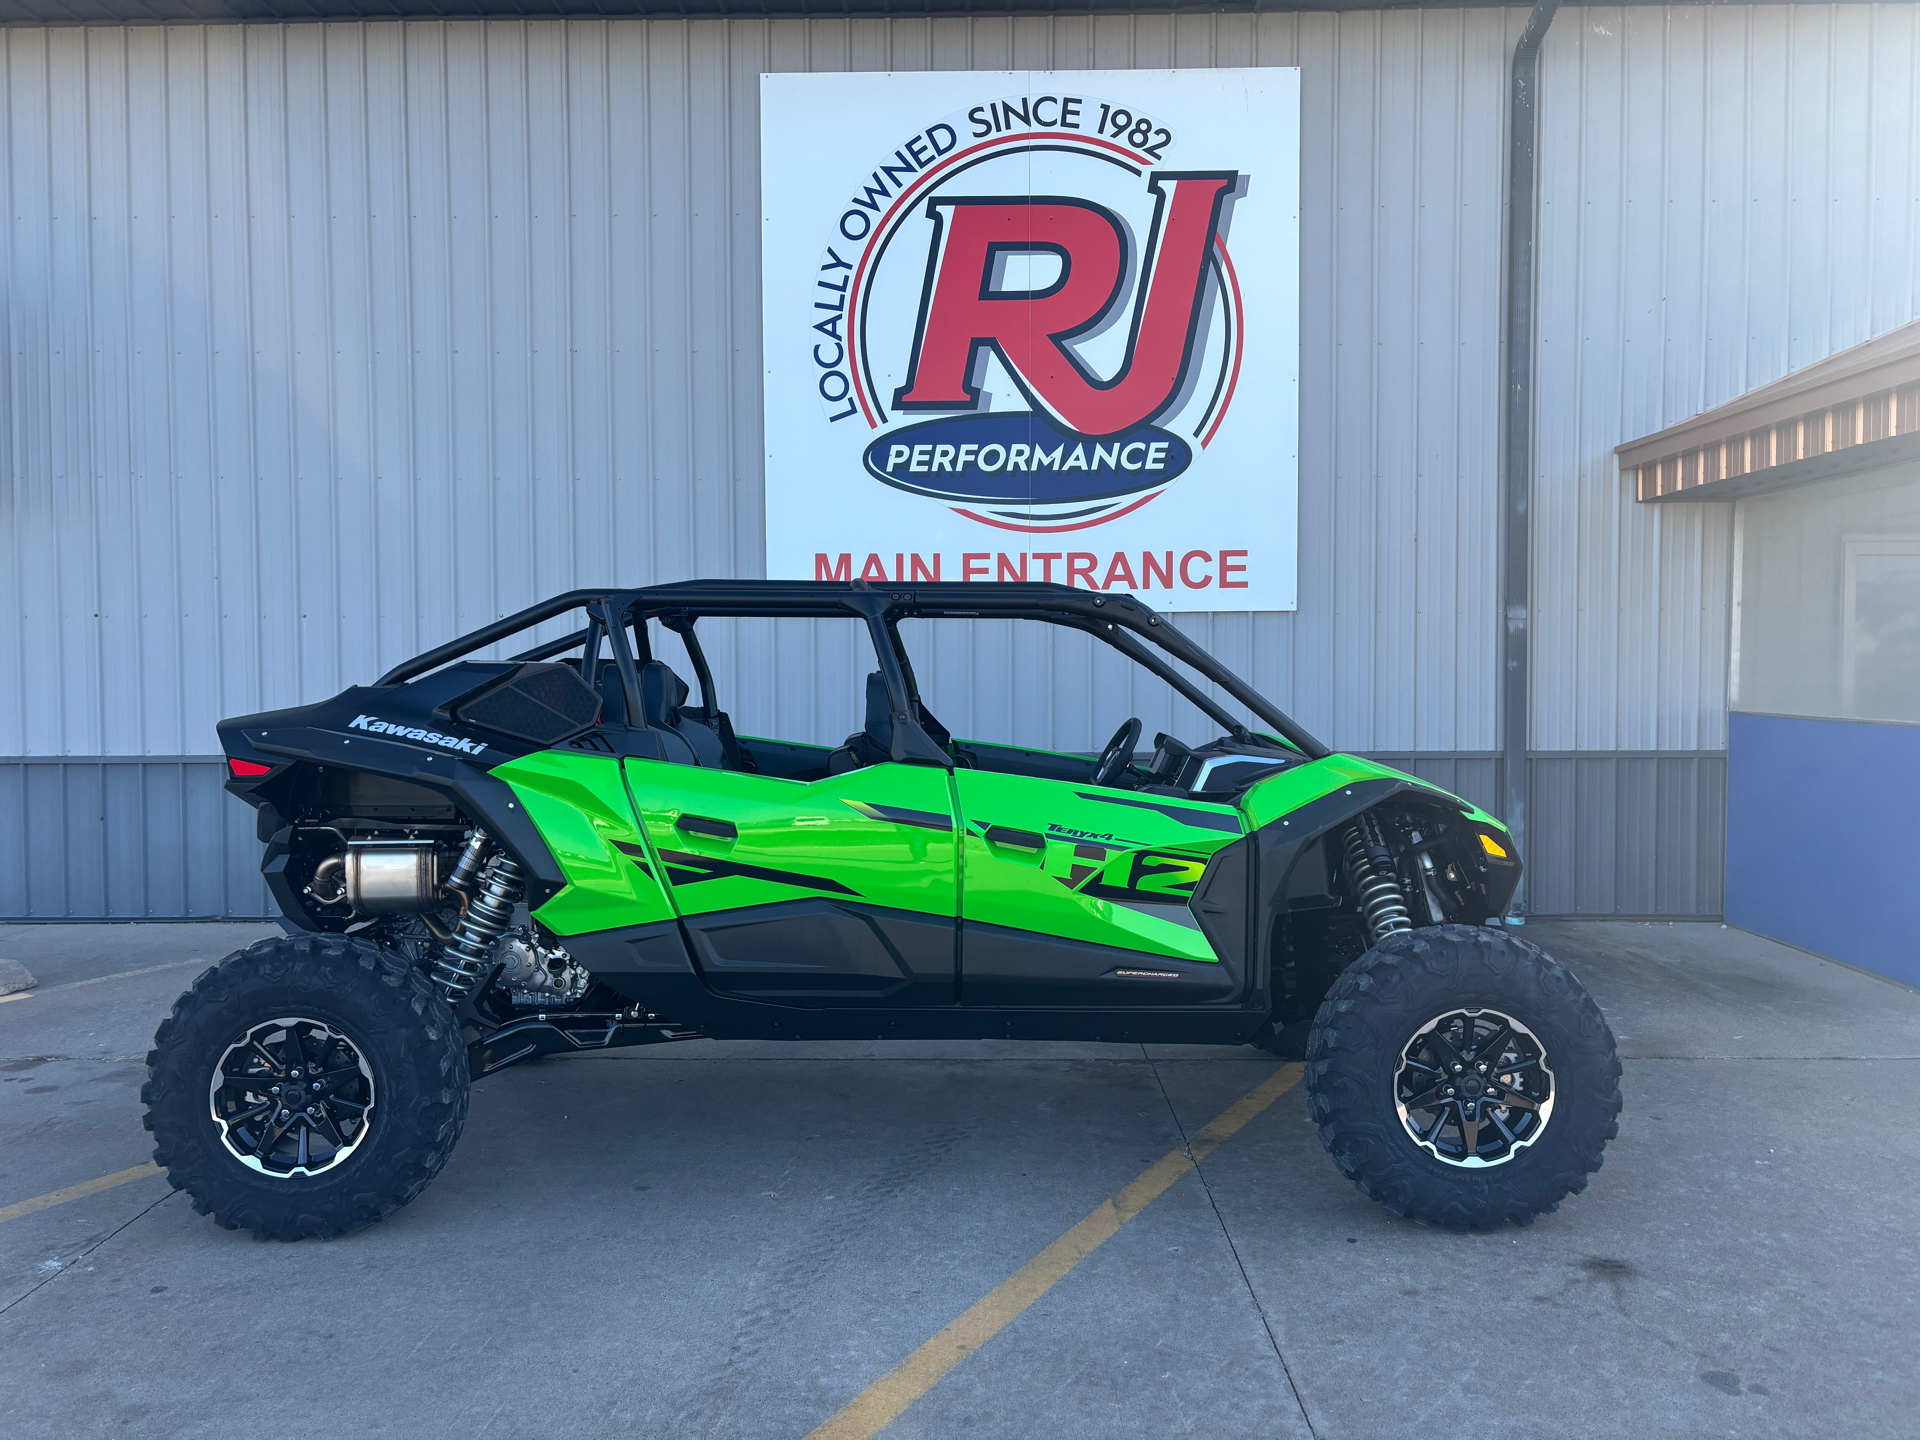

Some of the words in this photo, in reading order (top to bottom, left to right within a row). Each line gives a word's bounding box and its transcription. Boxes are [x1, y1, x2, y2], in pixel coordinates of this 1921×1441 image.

[813, 246, 858, 422] LOCALLY
[840, 123, 958, 241] OWNED
[968, 96, 1083, 138] SINCE
[1097, 103, 1172, 160] 1982
[891, 169, 1240, 442] RJ
[886, 442, 1170, 472] PERFORMANCE
[814, 552, 941, 582] MAIN
[962, 549, 1250, 590] ENTRANCE
[348, 714, 489, 755] Kawasaki
[1116, 970, 1179, 978] SUPERCHARGED
